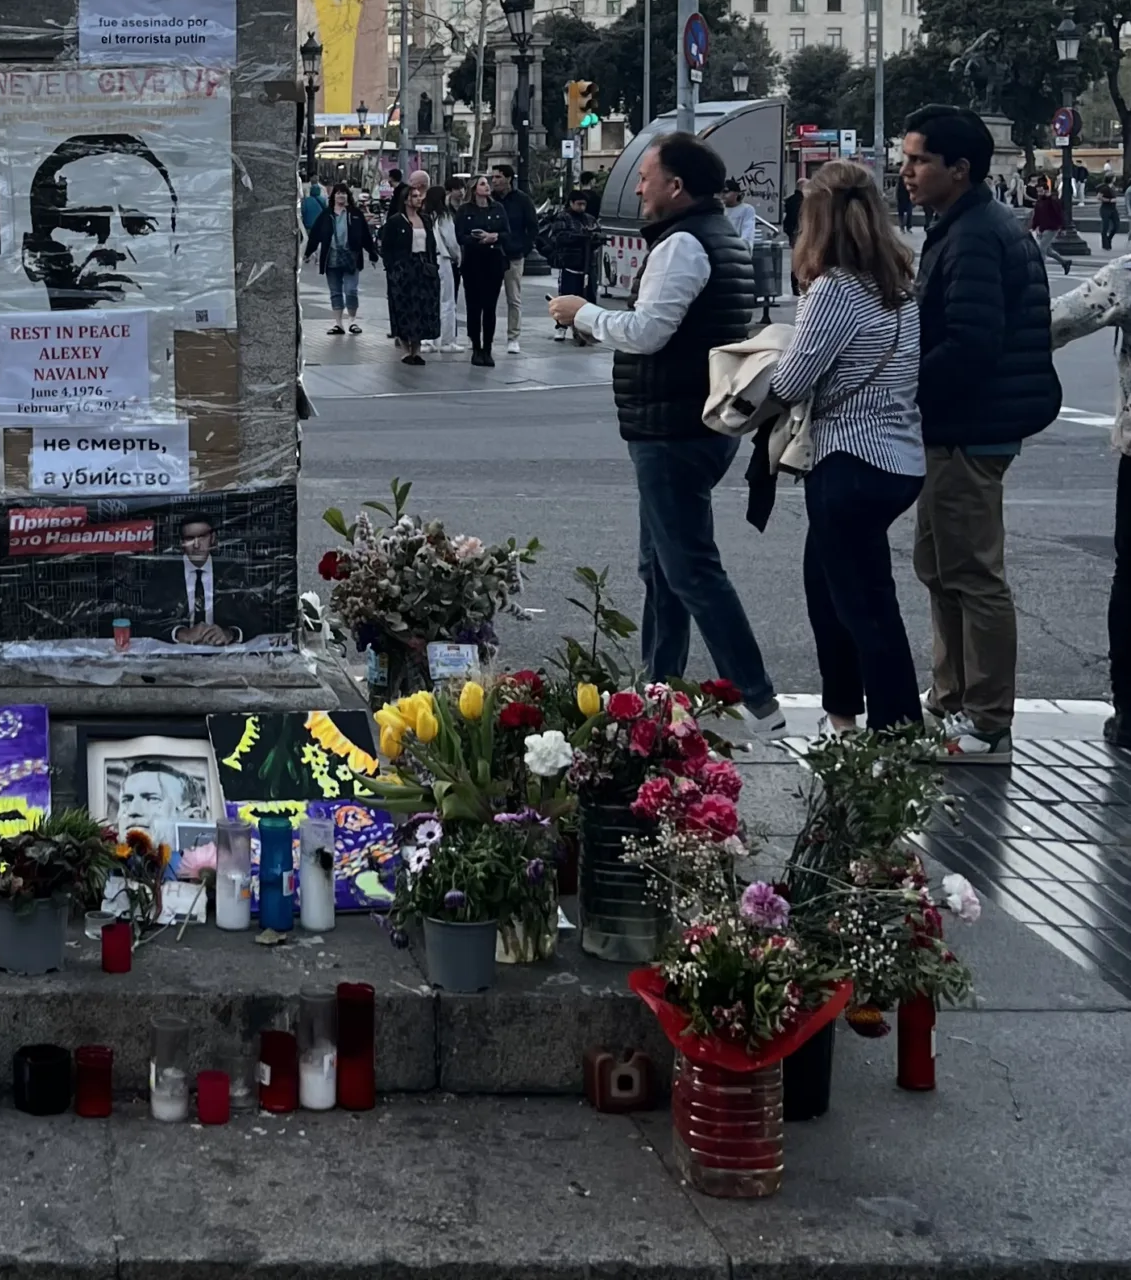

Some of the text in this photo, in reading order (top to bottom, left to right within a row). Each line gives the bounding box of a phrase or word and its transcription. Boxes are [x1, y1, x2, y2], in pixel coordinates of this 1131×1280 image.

[99, 17, 208, 29] fue asesinado por
[115, 33, 171, 44] terrorista
[175, 33, 206, 46] putin
[97, 68, 166, 95] GIVE
[10, 324, 130, 340] REST IN PEACE
[39, 346, 102, 360] ALEXEY
[34, 366, 110, 381] NAVALNY
[31, 387, 58, 400] June
[61, 386, 103, 398] 4,1976
[17, 403, 72, 414] February
[97, 401, 127, 412] 2024
[43, 438, 167, 454] не смерть,
[44, 467, 171, 489] а убийство
[9, 514, 86, 532] Привет,
[9, 526, 154, 546] это Навальный
